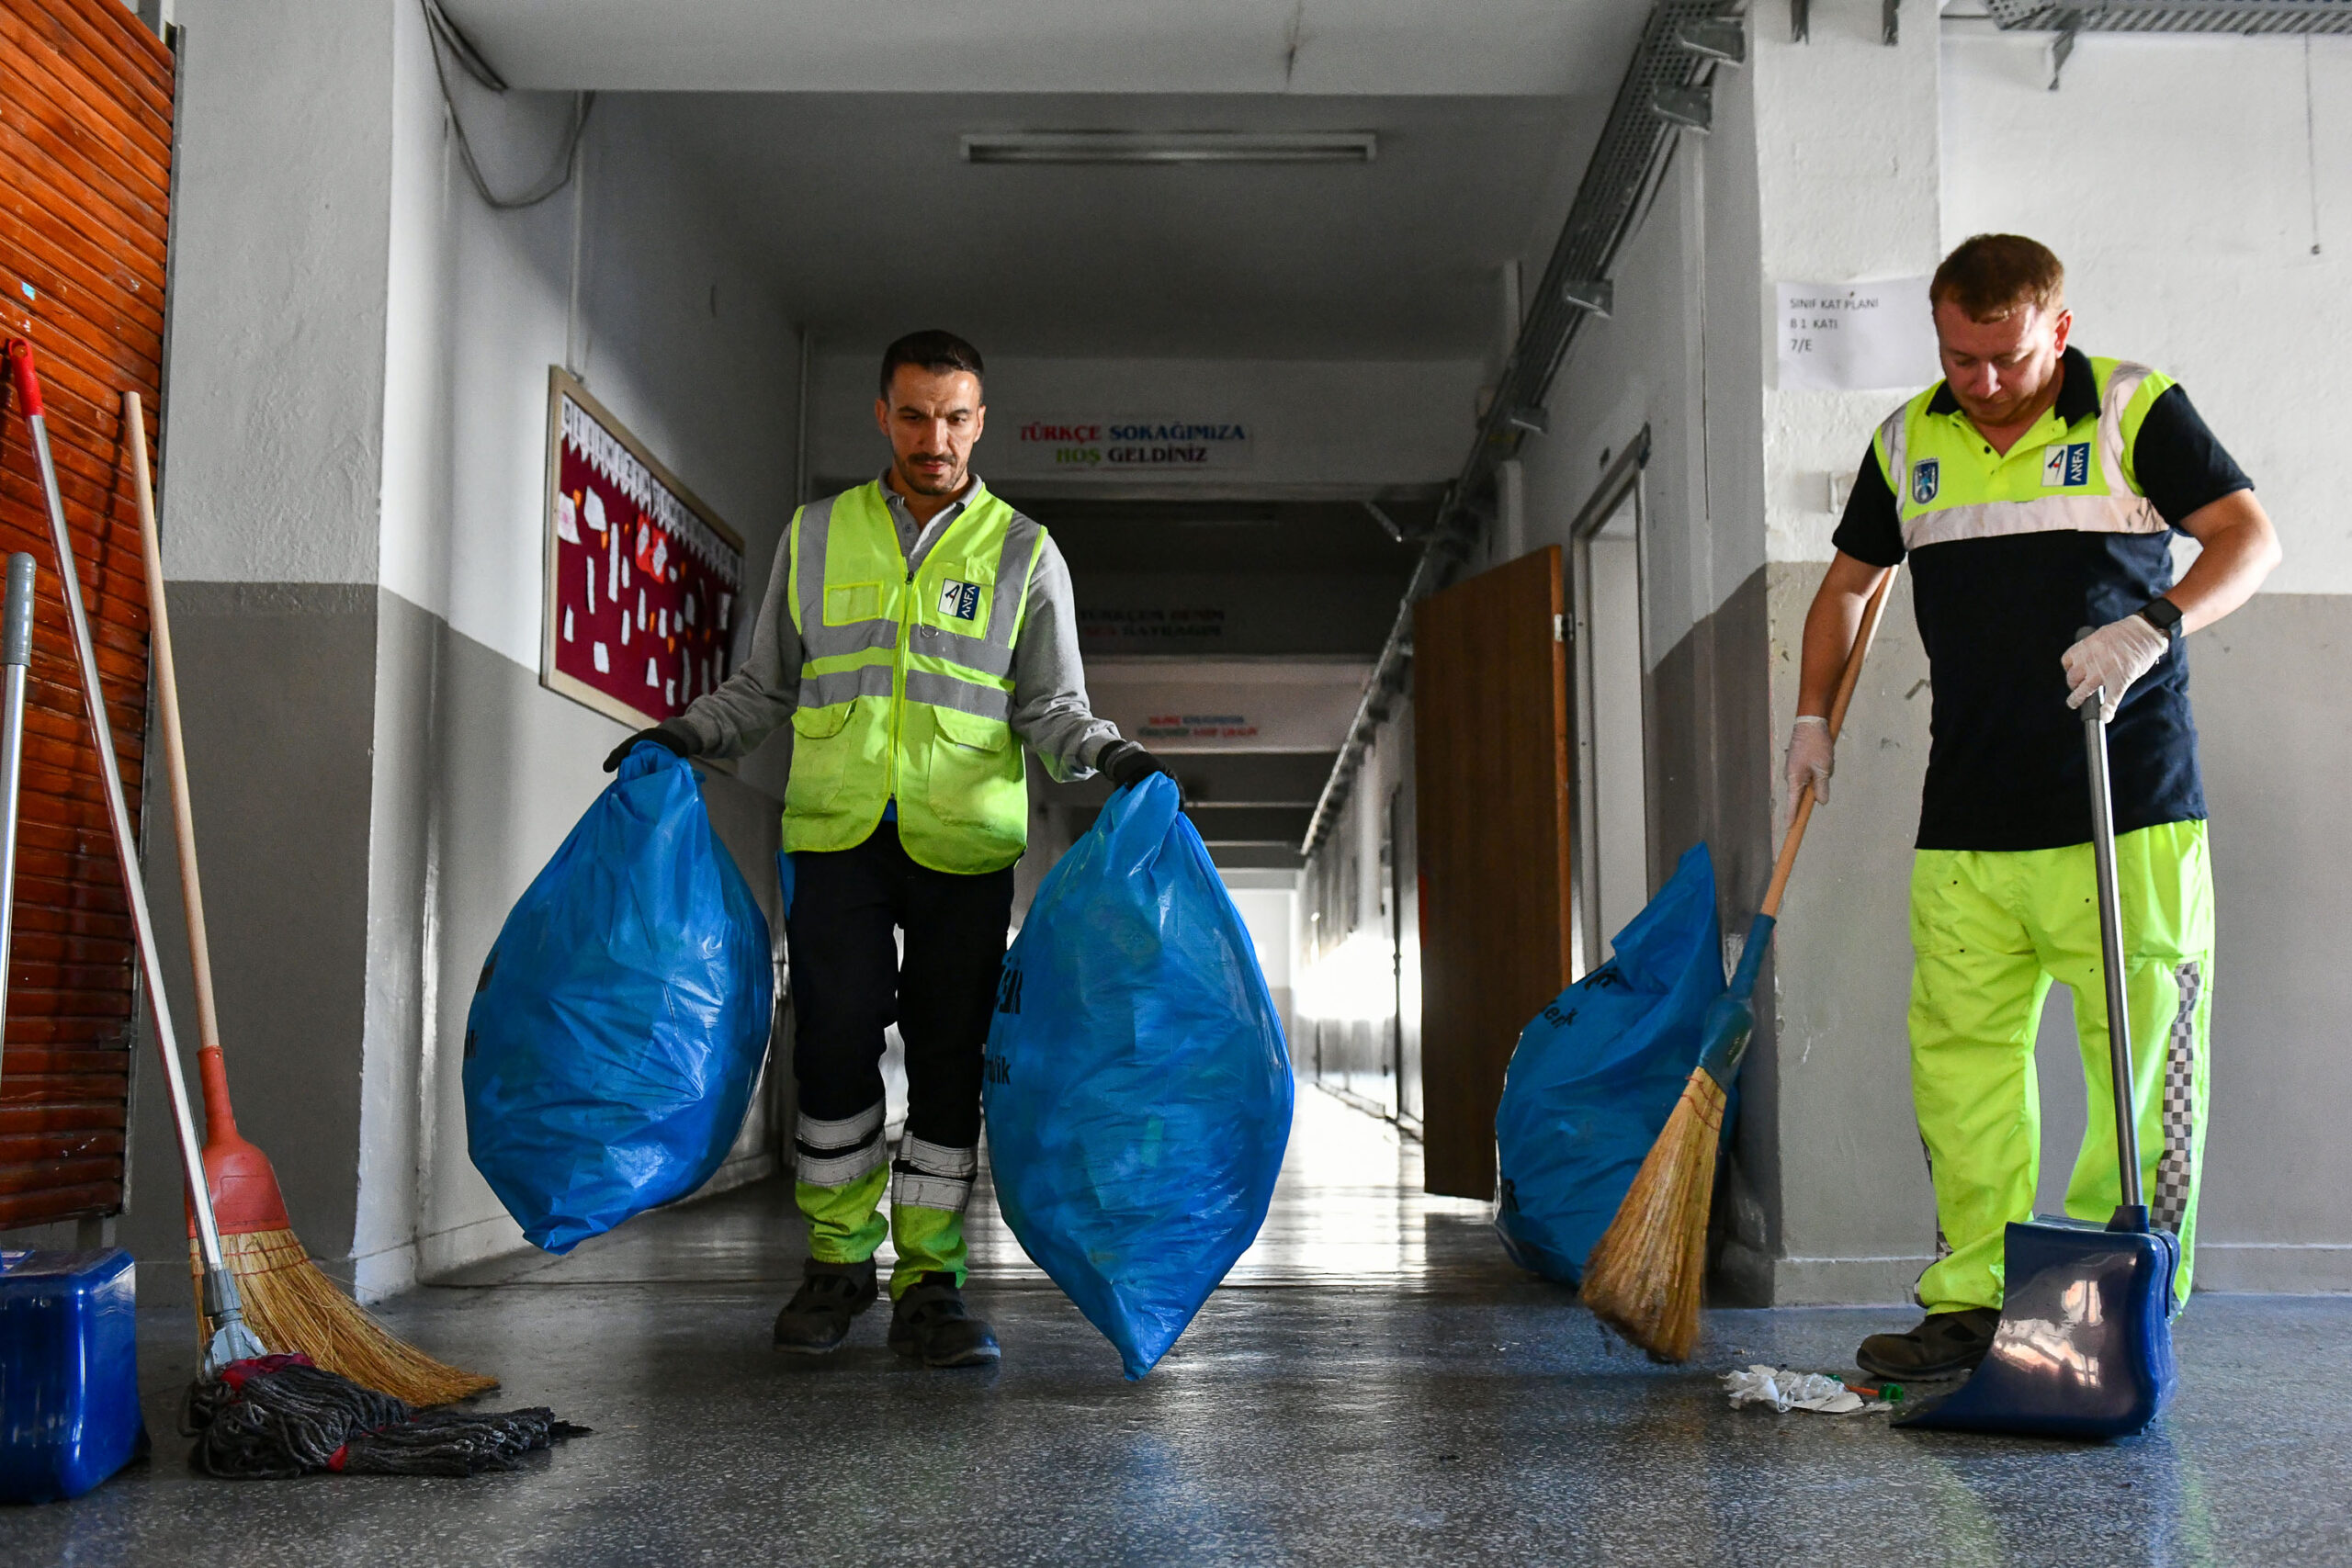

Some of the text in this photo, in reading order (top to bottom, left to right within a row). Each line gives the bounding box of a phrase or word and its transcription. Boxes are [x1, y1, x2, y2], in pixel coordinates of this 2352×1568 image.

[1790, 298, 1879, 310] SINIF KAT PLANI
[1814, 319, 1838, 329] KATI
[1791, 338, 1813, 353] 7/E
[1020, 422, 1245, 444] TÜRKÇE SOKAĞIMIZA
[1057, 444, 1207, 465] HOŞ GELDİNİZ
[2071, 446, 2085, 481] ANFA
[961, 586, 976, 618] ANFA
